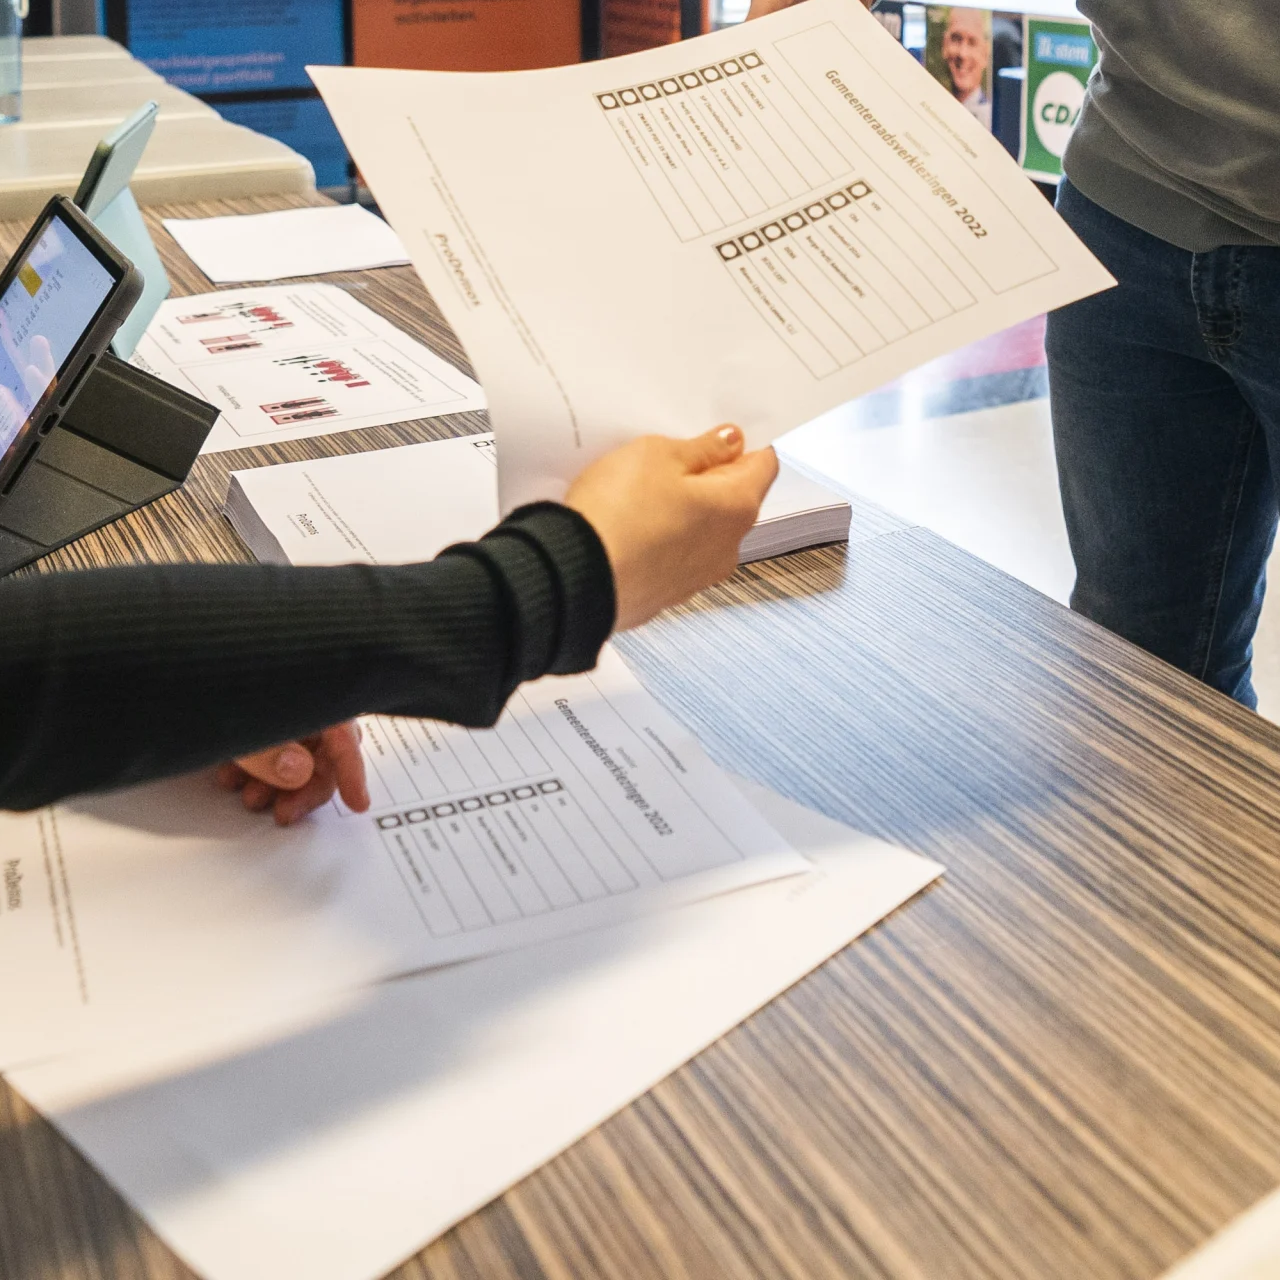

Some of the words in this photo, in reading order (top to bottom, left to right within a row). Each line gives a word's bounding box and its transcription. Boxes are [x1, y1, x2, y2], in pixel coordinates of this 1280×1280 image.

[826, 70, 958, 207] Gemeenteraadsverkiezingen
[955, 208, 987, 238] 2022
[554, 699, 650, 813] Gemeenteraadsverkiezingen
[644, 810, 673, 836] 2022
